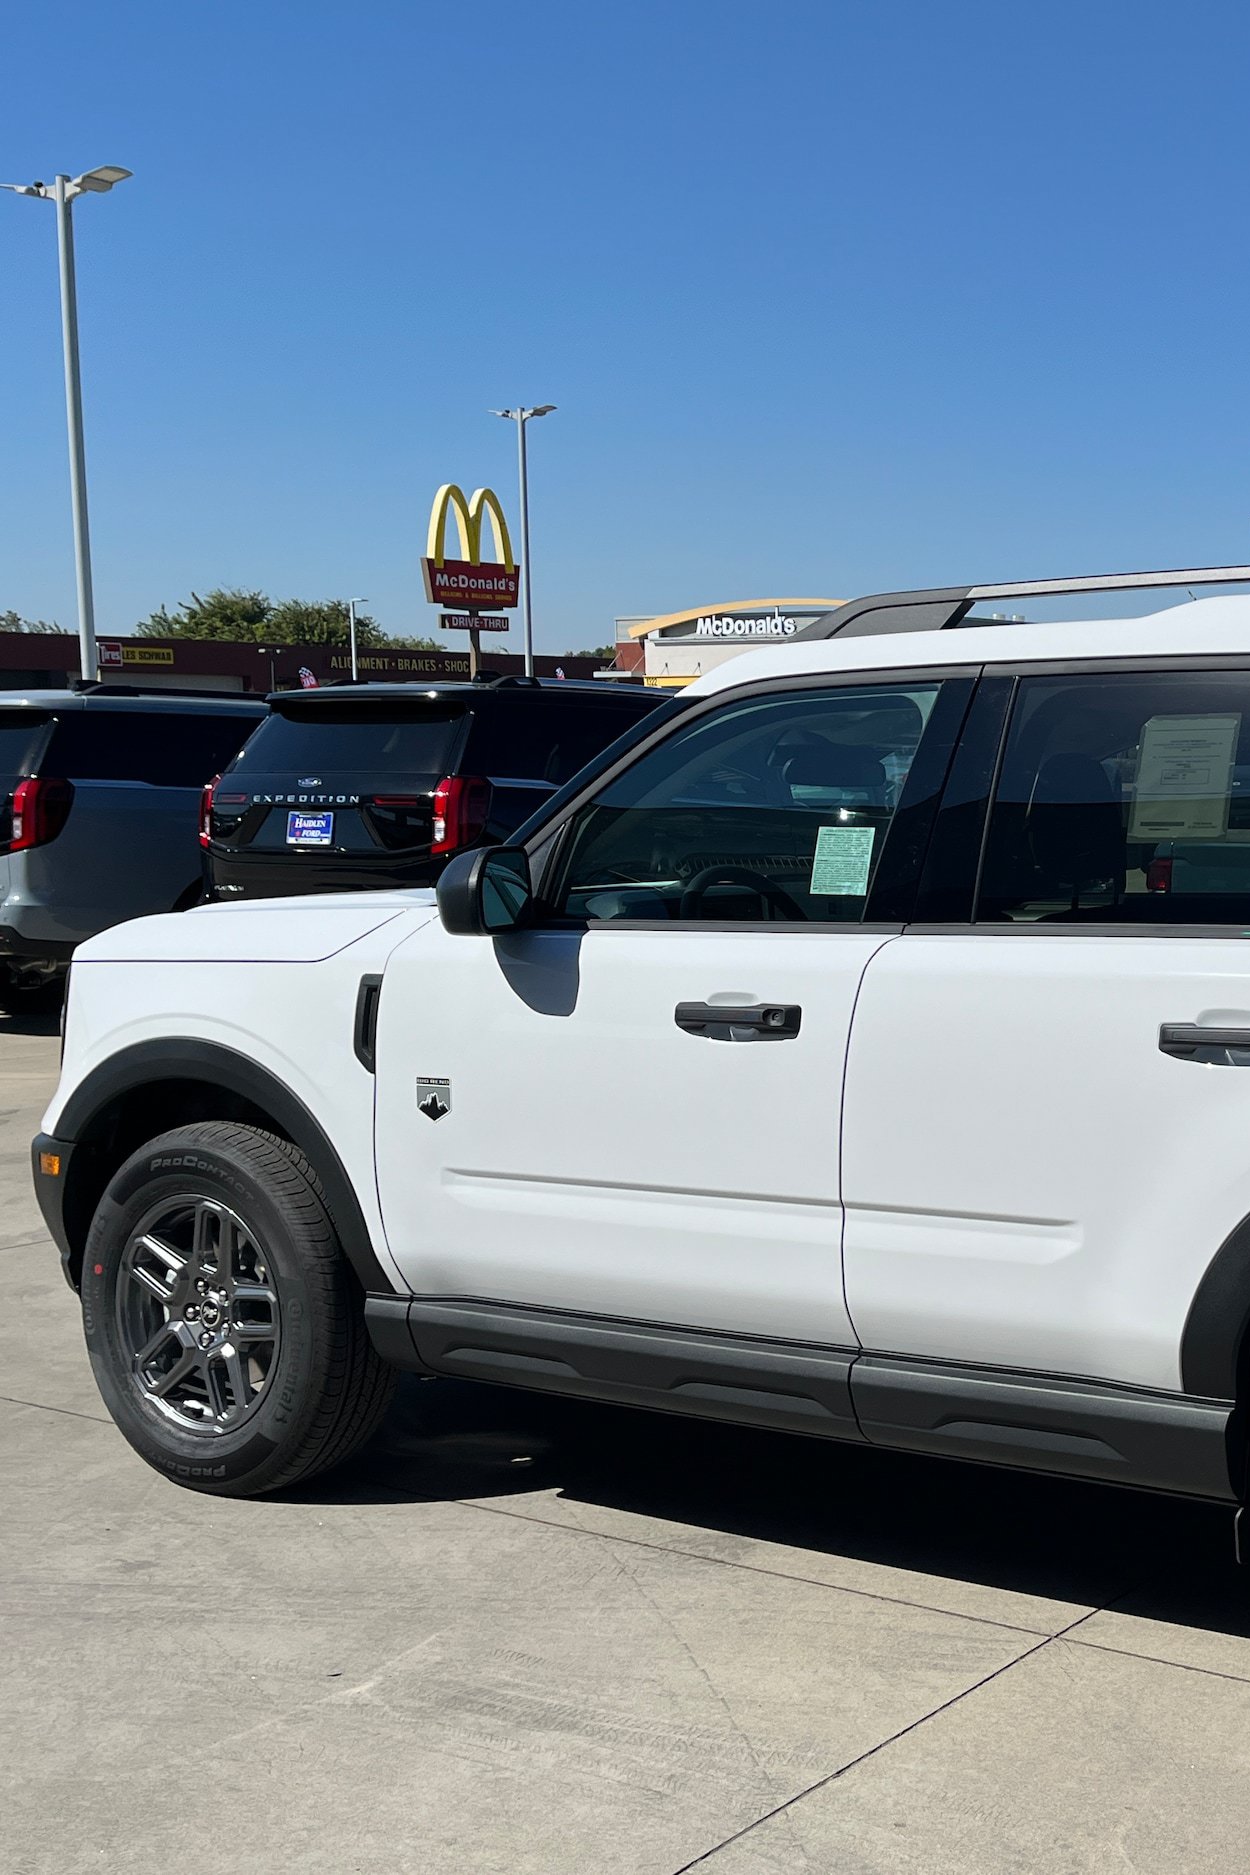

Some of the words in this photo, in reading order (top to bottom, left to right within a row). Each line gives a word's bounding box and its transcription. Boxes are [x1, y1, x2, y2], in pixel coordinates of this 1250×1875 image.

[435, 573, 515, 592] McDonald's
[452, 616, 508, 629] DRIVE-THRU
[696, 616, 796, 636] McDonald's
[397, 659, 436, 672] BRAKES
[253, 795, 360, 803] EXPEDITION
